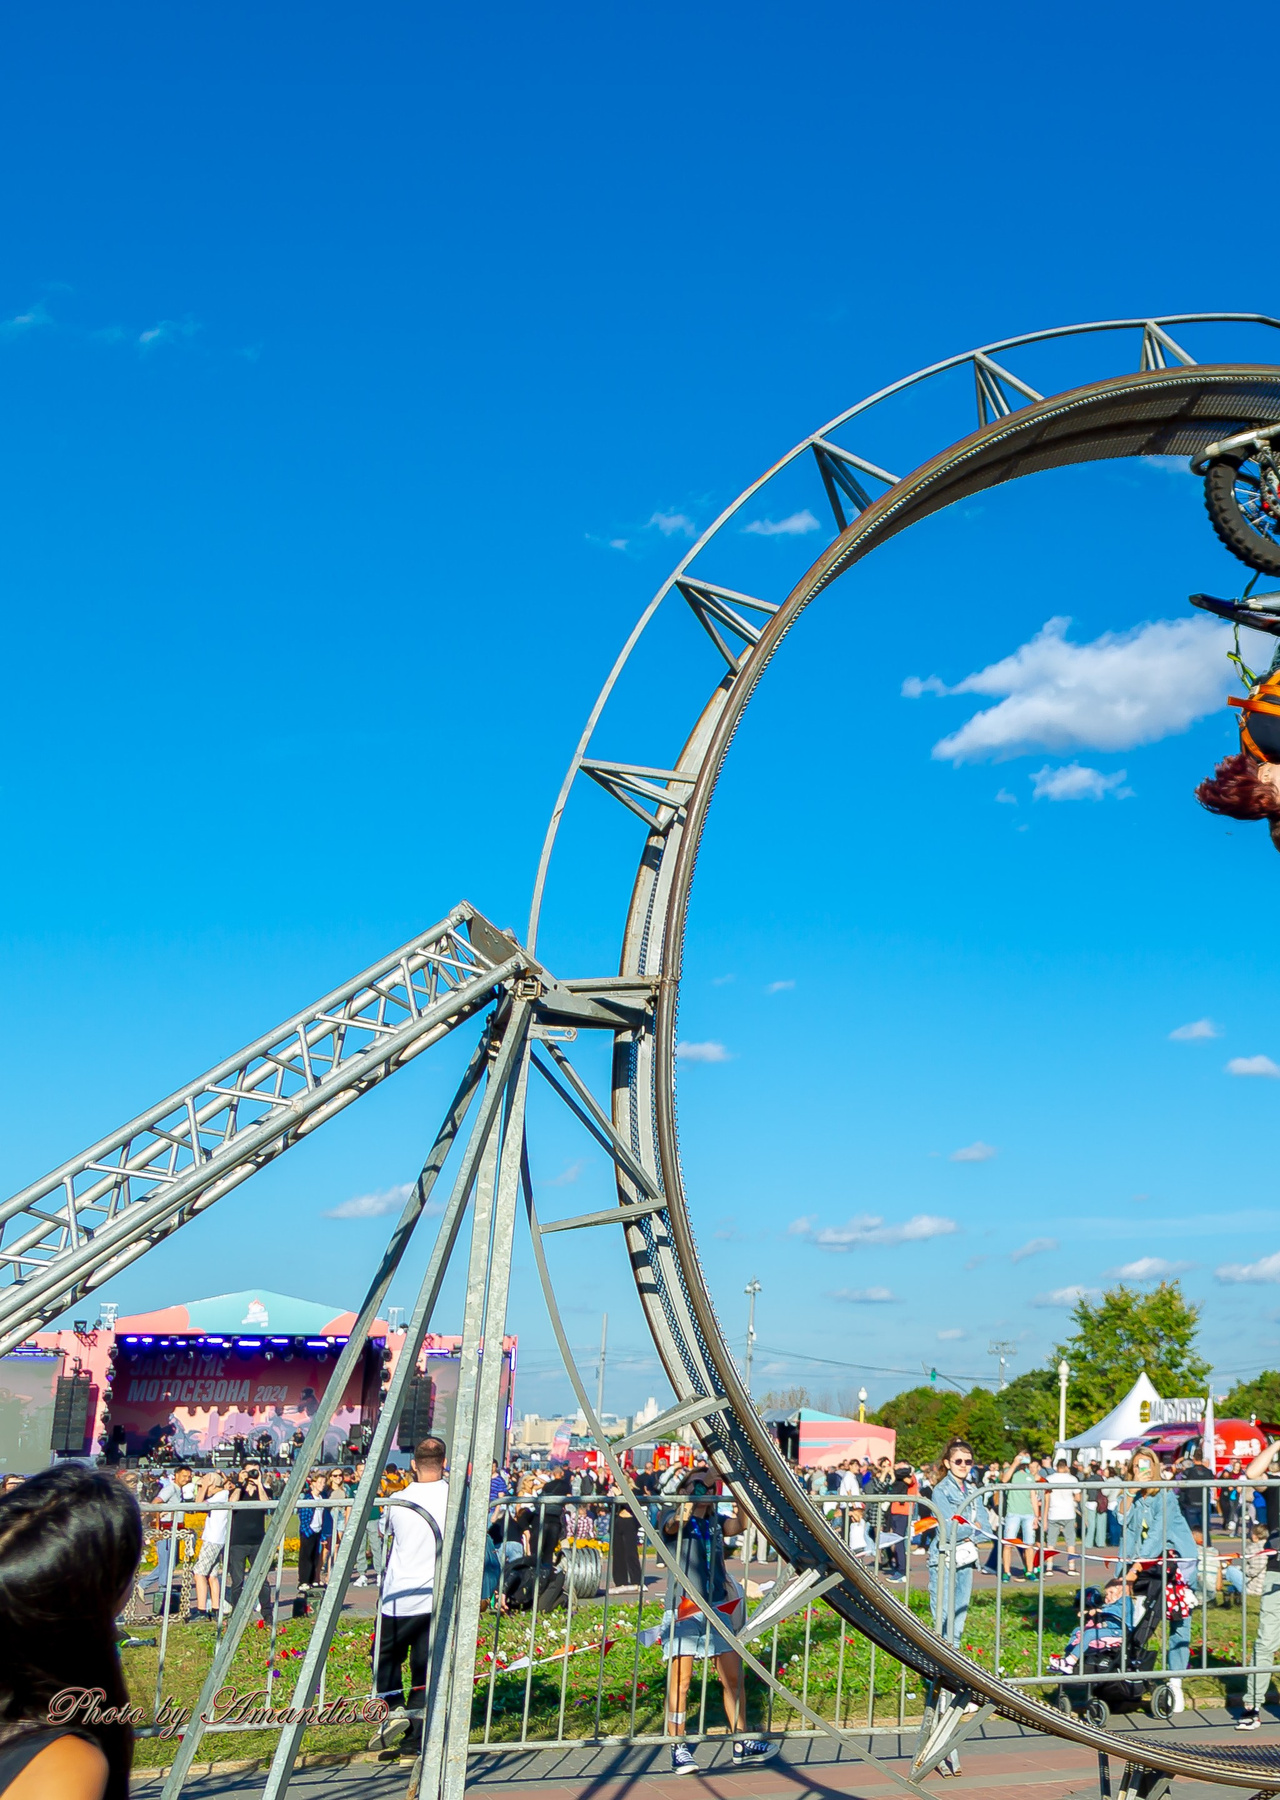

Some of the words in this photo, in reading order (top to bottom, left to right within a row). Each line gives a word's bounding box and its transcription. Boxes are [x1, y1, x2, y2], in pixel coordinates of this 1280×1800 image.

[129, 1354, 225, 1376] ЗАКРЫТИЕ
[126, 1379, 251, 1402] МОТОСЕЗОНА
[253, 1385, 289, 1402] 2024
